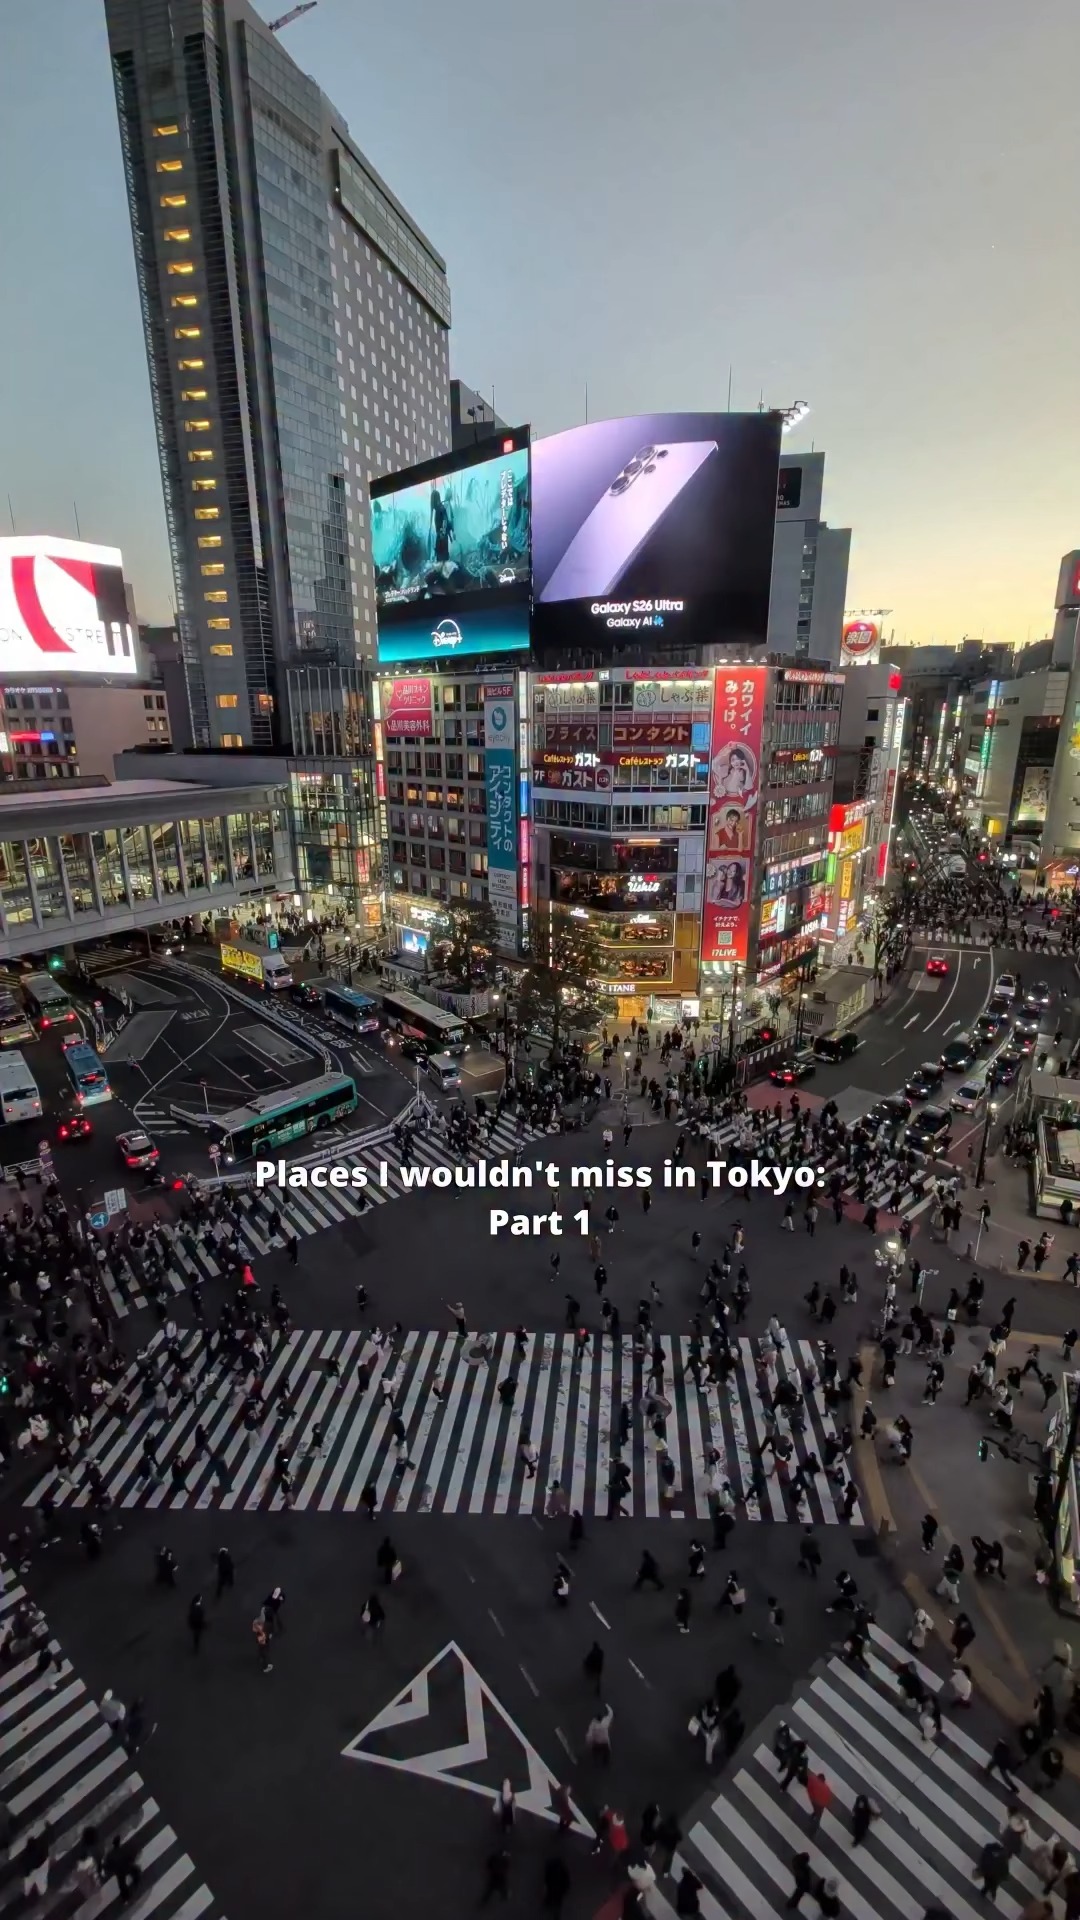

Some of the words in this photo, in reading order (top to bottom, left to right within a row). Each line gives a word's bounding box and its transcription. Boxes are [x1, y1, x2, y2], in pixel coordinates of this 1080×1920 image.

[591, 602, 631, 615] Galaxy
[633, 600, 653, 612] S26
[655, 600, 684, 611] Ultra
[607, 617, 641, 629] Galaxy
[643, 616, 652, 626] AI
[660, 686, 709, 703] しゃぶ葉
[724, 680, 738, 729] みっけ。
[740, 680, 754, 735] カワイイ
[546, 726, 597, 741] プライス
[614, 726, 689, 742] コンタクト
[575, 752, 601, 768] ガスト
[665, 754, 700, 768] ガスト
[534, 770, 545, 781] 7F
[562, 769, 592, 787] ガスト
[801, 919, 819, 936] LUSH
